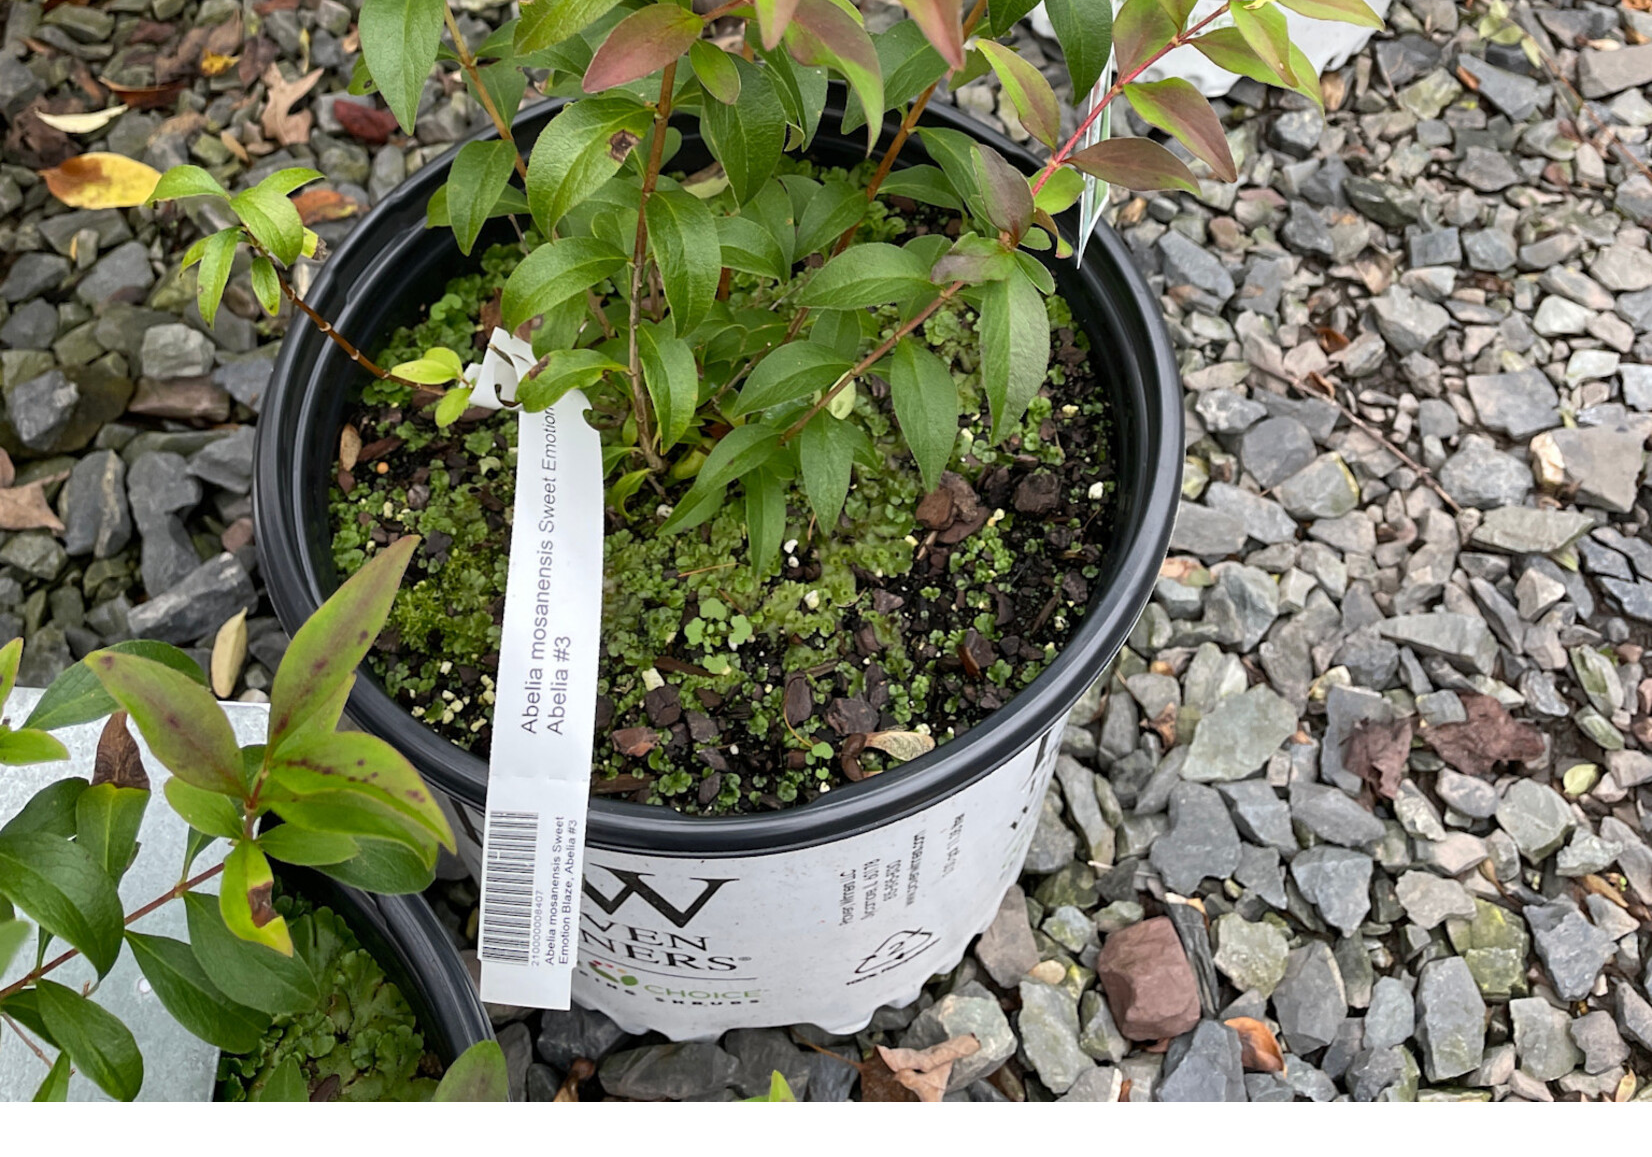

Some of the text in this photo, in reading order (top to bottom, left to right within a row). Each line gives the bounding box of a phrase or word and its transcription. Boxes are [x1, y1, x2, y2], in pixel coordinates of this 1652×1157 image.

[538, 477, 557, 534] Sweet
[530, 540, 555, 662] mosanensis
[521, 667, 543, 735] Abelia
[547, 636, 572, 736] Abelia #3
[544, 816, 564, 966] Abelia mosanensis Sweet
[559, 819, 578, 965] Emotion Blaze, Abelia #3
[582, 911, 711, 952] VEN
[644, 984, 763, 999] CHOICE
